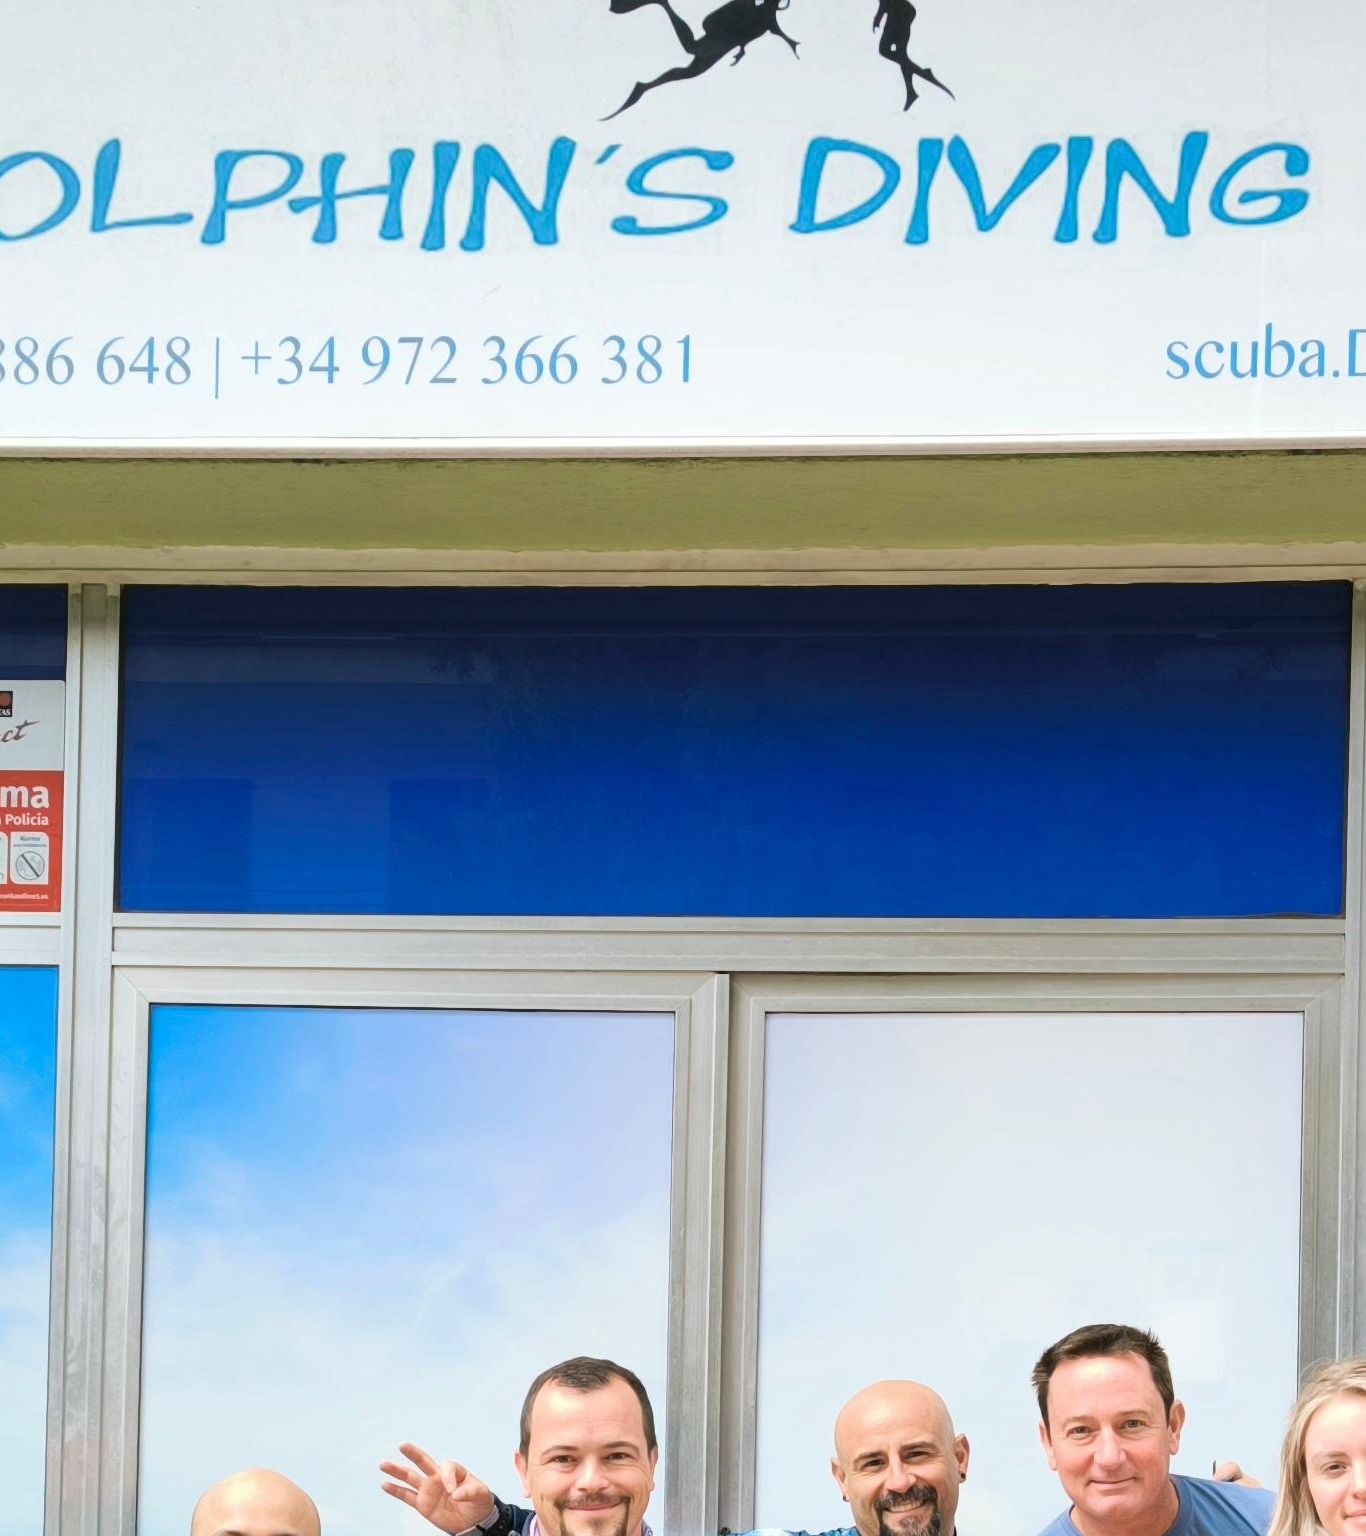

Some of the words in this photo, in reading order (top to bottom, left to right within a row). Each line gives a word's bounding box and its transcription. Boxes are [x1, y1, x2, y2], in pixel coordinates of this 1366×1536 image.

[788, 130, 1310, 247] DIVING
[94, 336, 193, 386] 648
[240, 335, 340, 386] +34
[360, 335, 459, 386] 972
[481, 335, 579, 386] 366
[599, 334, 695, 385] 381
[4, 812, 49, 826] Policía
